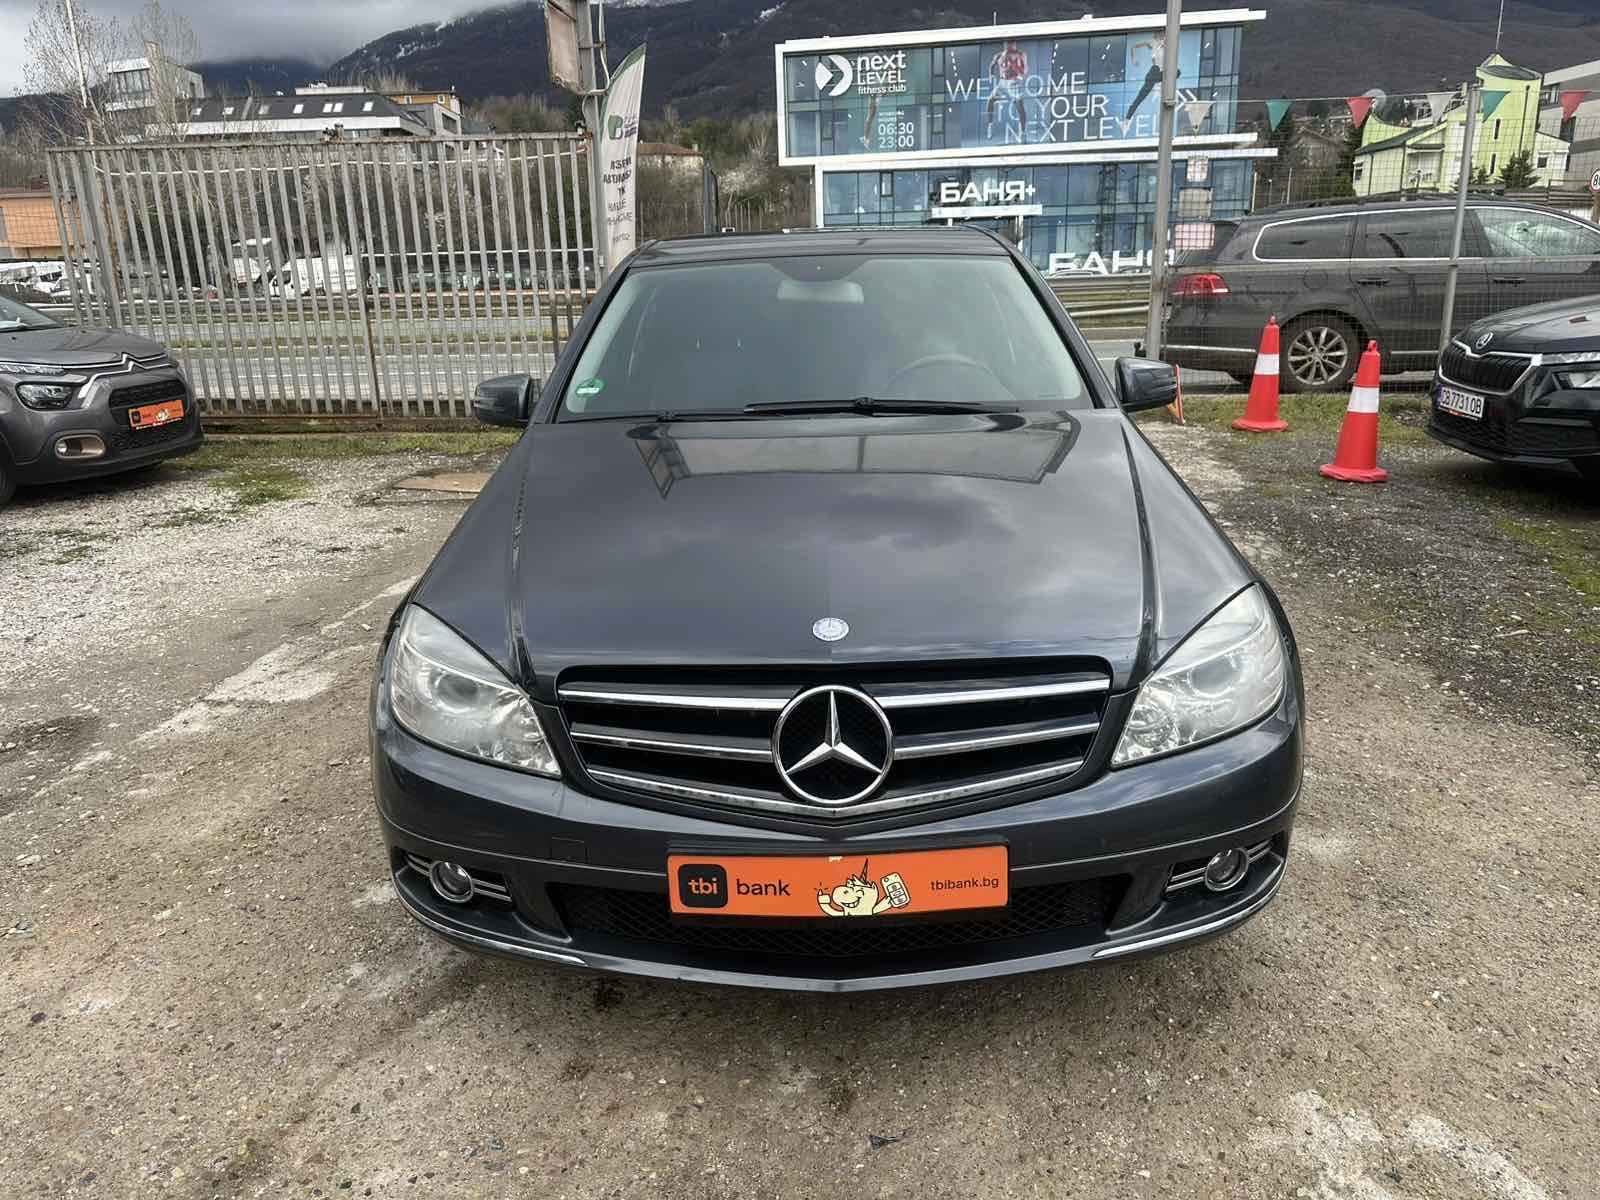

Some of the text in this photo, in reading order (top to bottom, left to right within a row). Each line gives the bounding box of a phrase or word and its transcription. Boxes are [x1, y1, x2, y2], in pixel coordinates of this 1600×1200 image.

[857, 50, 906, 71] next
[857, 70, 906, 86] LEVEL
[946, 72, 1086, 101] WELCOME
[858, 84, 907, 95] fitness club
[993, 95, 1108, 121] TO YOUR
[878, 122, 914, 136] 06:30
[1004, 112, 1161, 144] NEXT LEVEL
[878, 135, 914, 149] 23:00
[688, 877, 791, 896] tbi bank
[930, 876, 1000, 890] tbibank.bg
